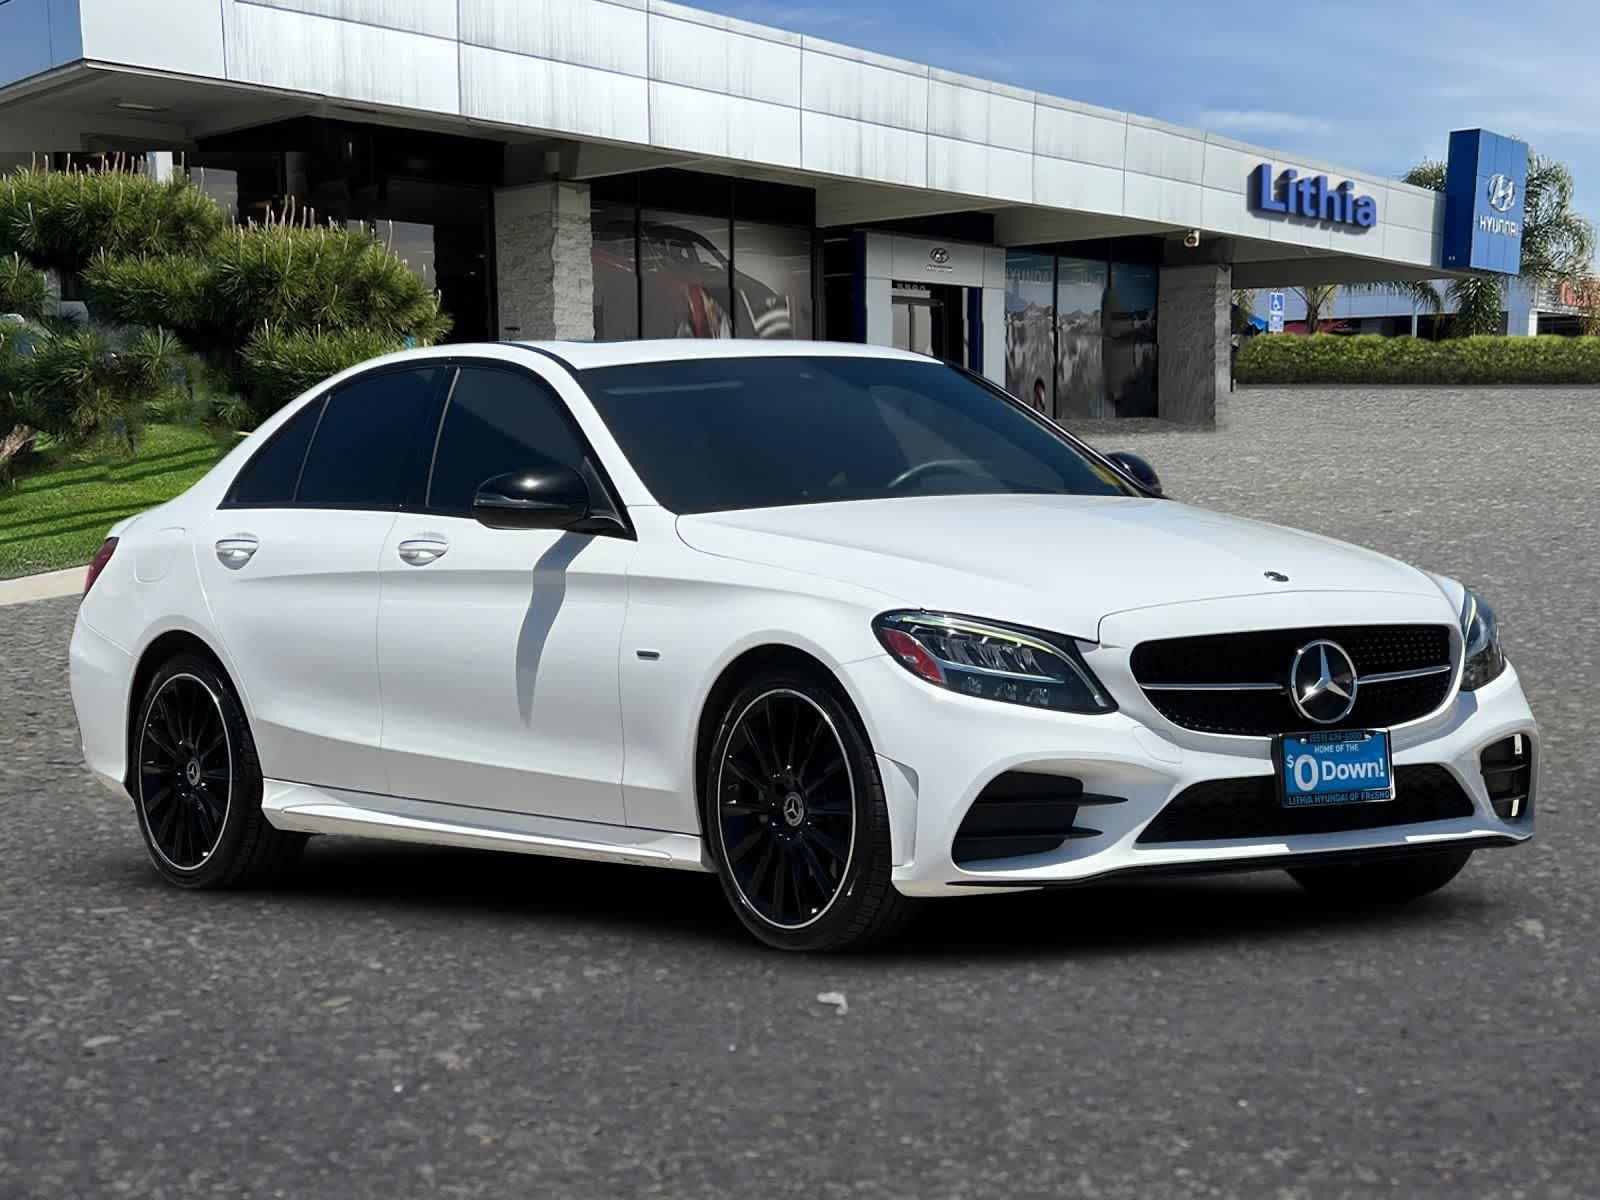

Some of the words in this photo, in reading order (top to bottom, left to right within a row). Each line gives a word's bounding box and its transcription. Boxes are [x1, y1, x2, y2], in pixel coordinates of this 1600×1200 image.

[1251, 163, 1376, 230] Lithia
[1479, 215, 1520, 238] HYUNDAI
[1313, 743, 1335, 753] HOME
[1335, 743, 1345, 753] OF
[1346, 743, 1360, 752] THE
[1321, 757, 1385, 781] Down!
